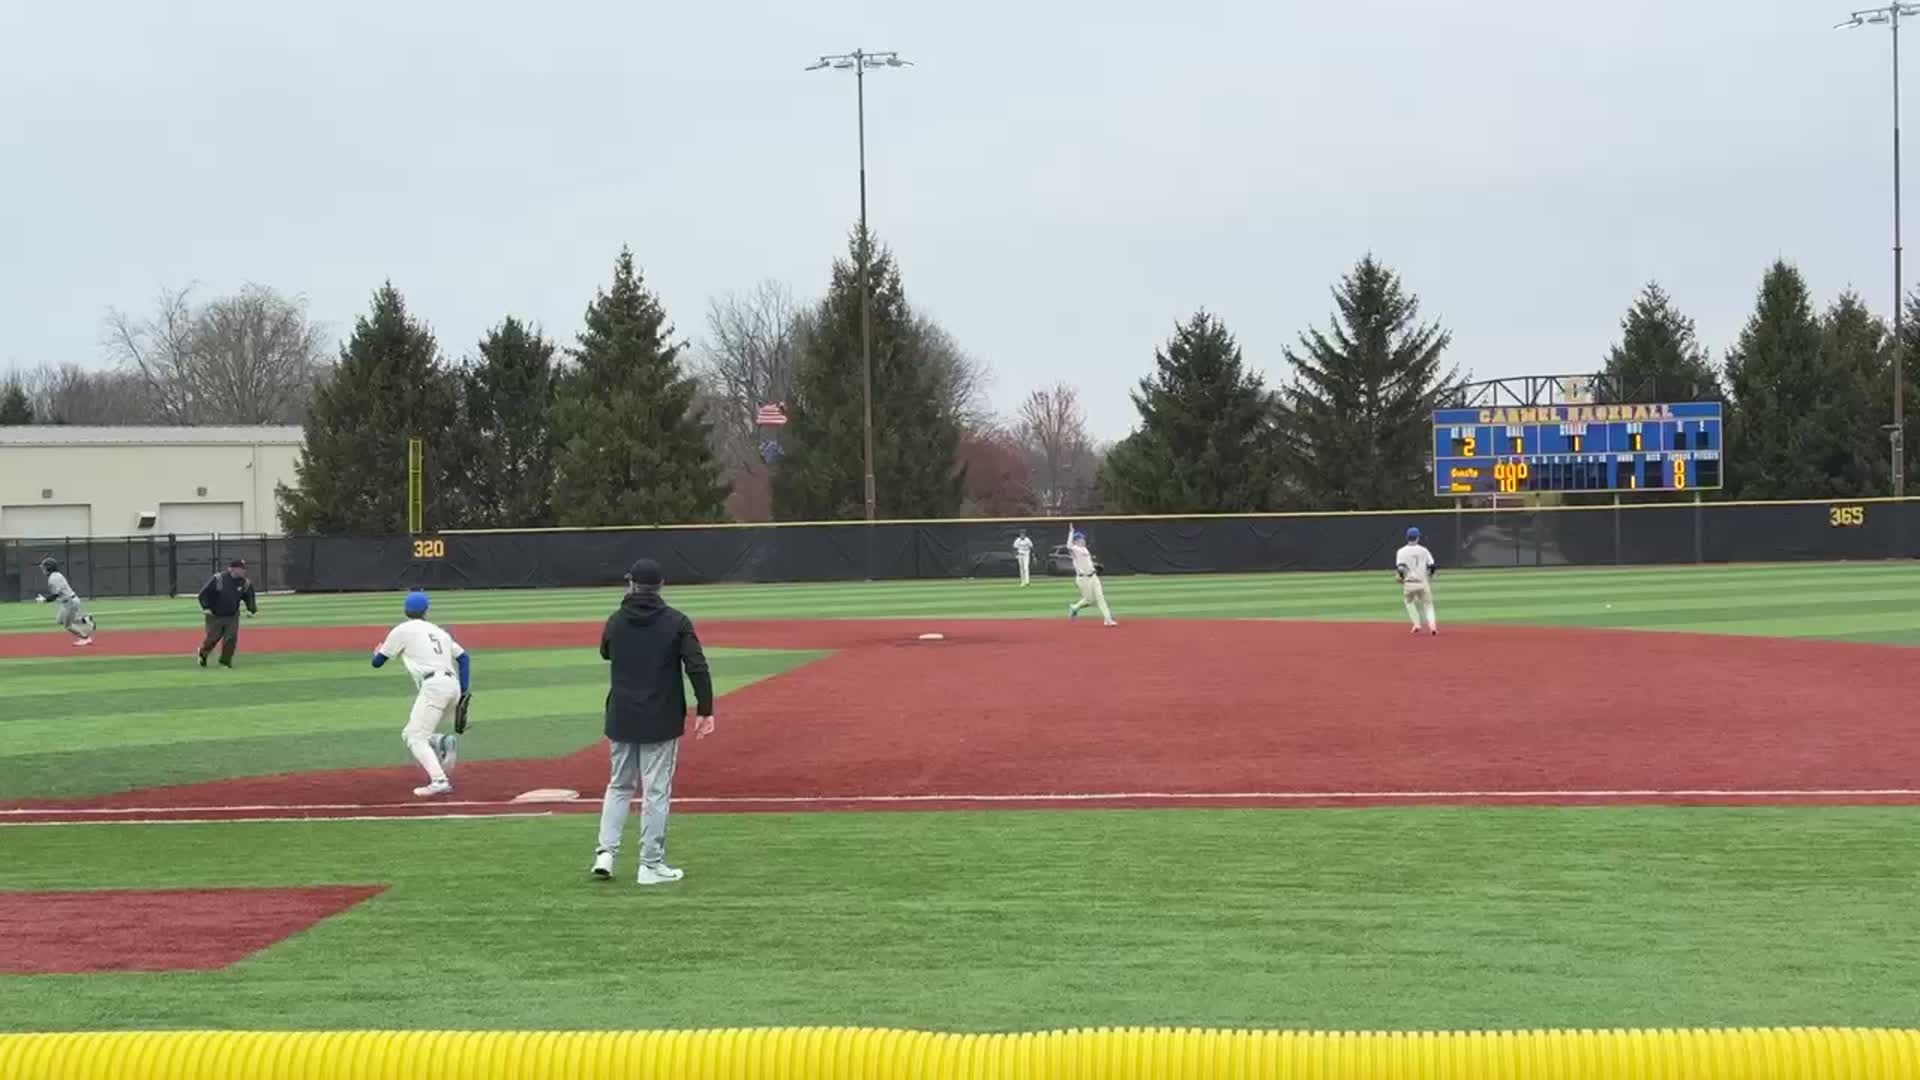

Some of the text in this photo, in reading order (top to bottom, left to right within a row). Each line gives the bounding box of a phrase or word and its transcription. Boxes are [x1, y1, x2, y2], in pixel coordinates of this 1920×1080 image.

[1463, 436, 1475, 457] 2
[1829, 506, 1864, 526] 365
[413, 540, 445, 558] 320
[428, 632, 443, 655] 5
